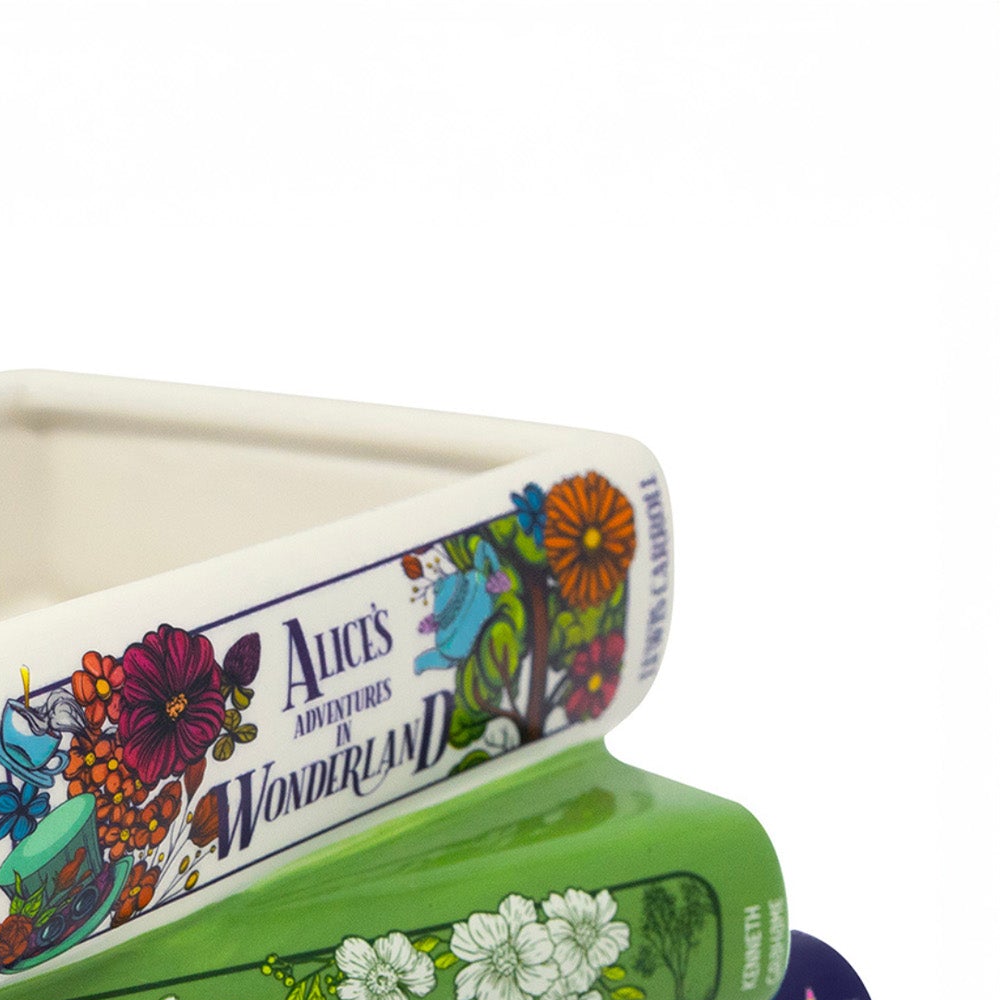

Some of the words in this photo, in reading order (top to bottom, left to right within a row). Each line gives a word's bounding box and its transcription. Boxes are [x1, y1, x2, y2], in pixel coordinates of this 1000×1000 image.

[293, 678, 393, 739] ADVENTURES
[336, 720, 353, 748] IN
[213, 689, 456, 860] WONDERLAND
[741, 904, 762, 992] KENNETH
